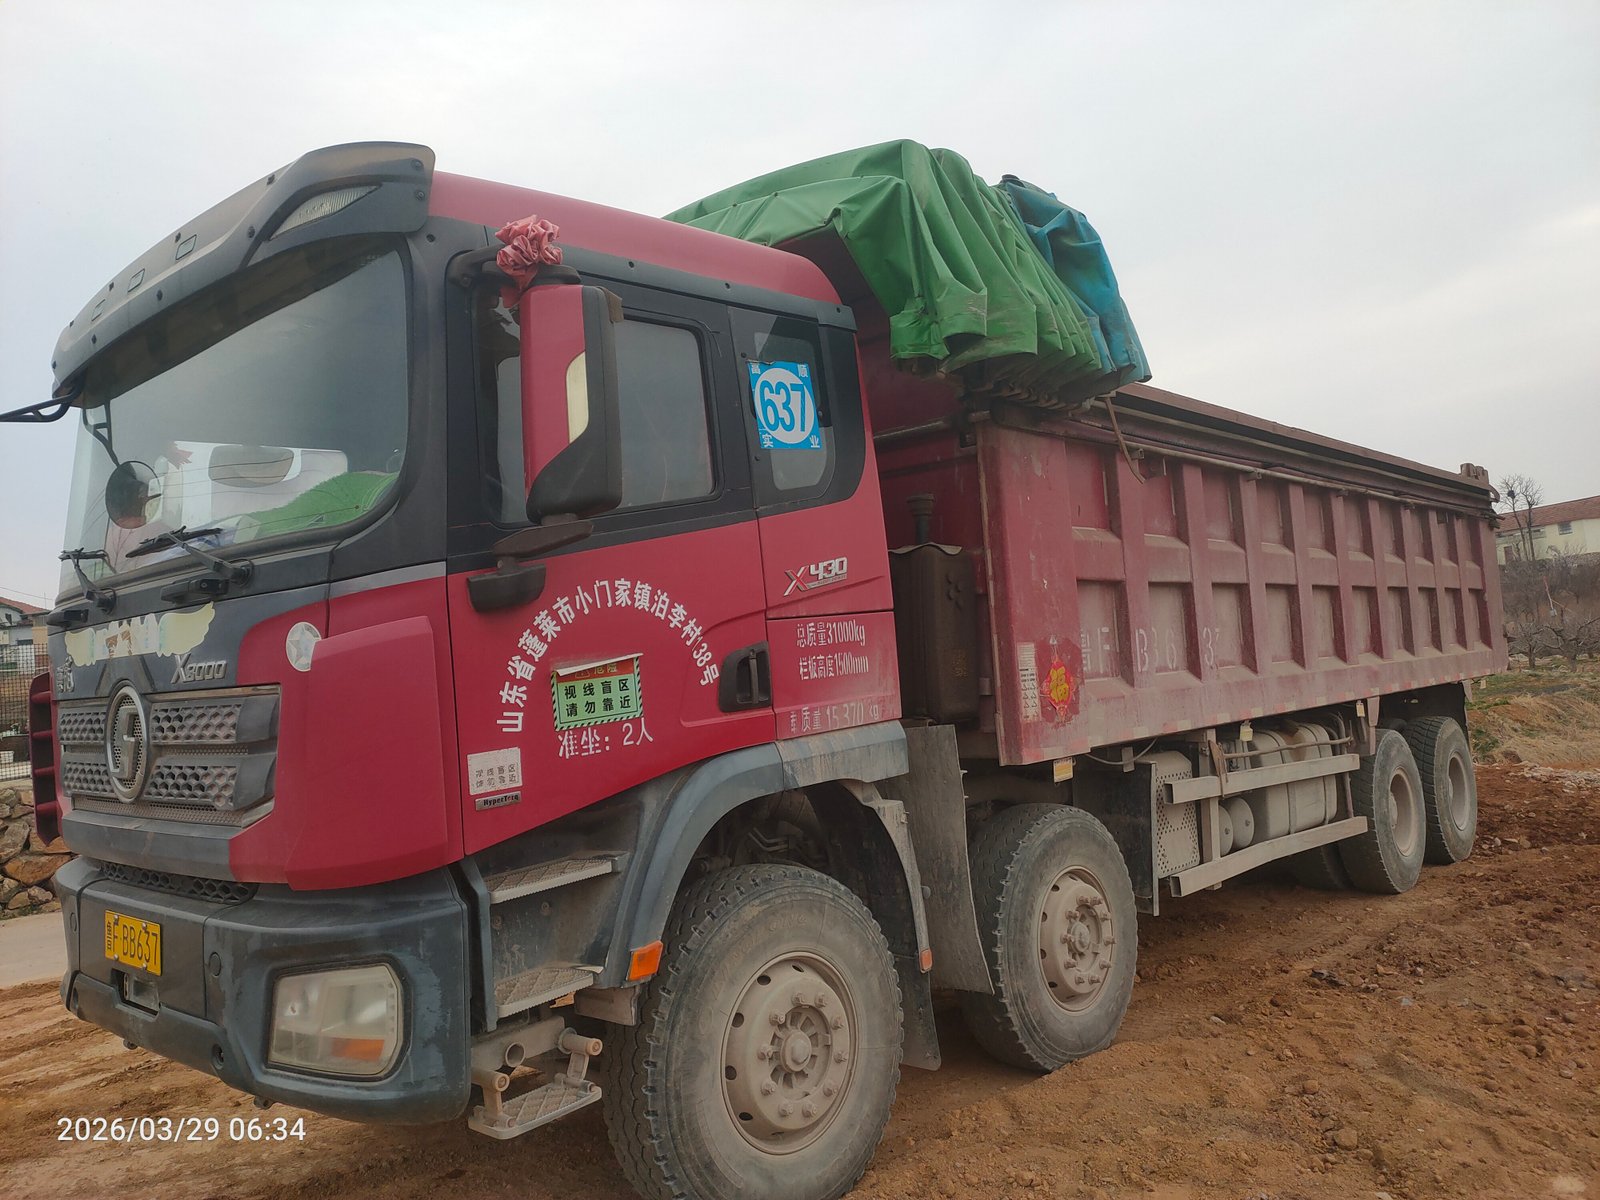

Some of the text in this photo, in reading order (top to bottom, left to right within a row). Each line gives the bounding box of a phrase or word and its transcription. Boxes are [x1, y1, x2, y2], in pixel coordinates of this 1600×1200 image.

[760, 379, 806, 432] 637
[783, 556, 849, 596] X430
[796, 619, 866, 648] 总质量31000kg
[799, 653, 870, 680] 栏板高度1500mm
[564, 678, 630, 700] 视线盲区
[1049, 666, 1069, 704] 福
[565, 695, 632, 718] 请勿靠近
